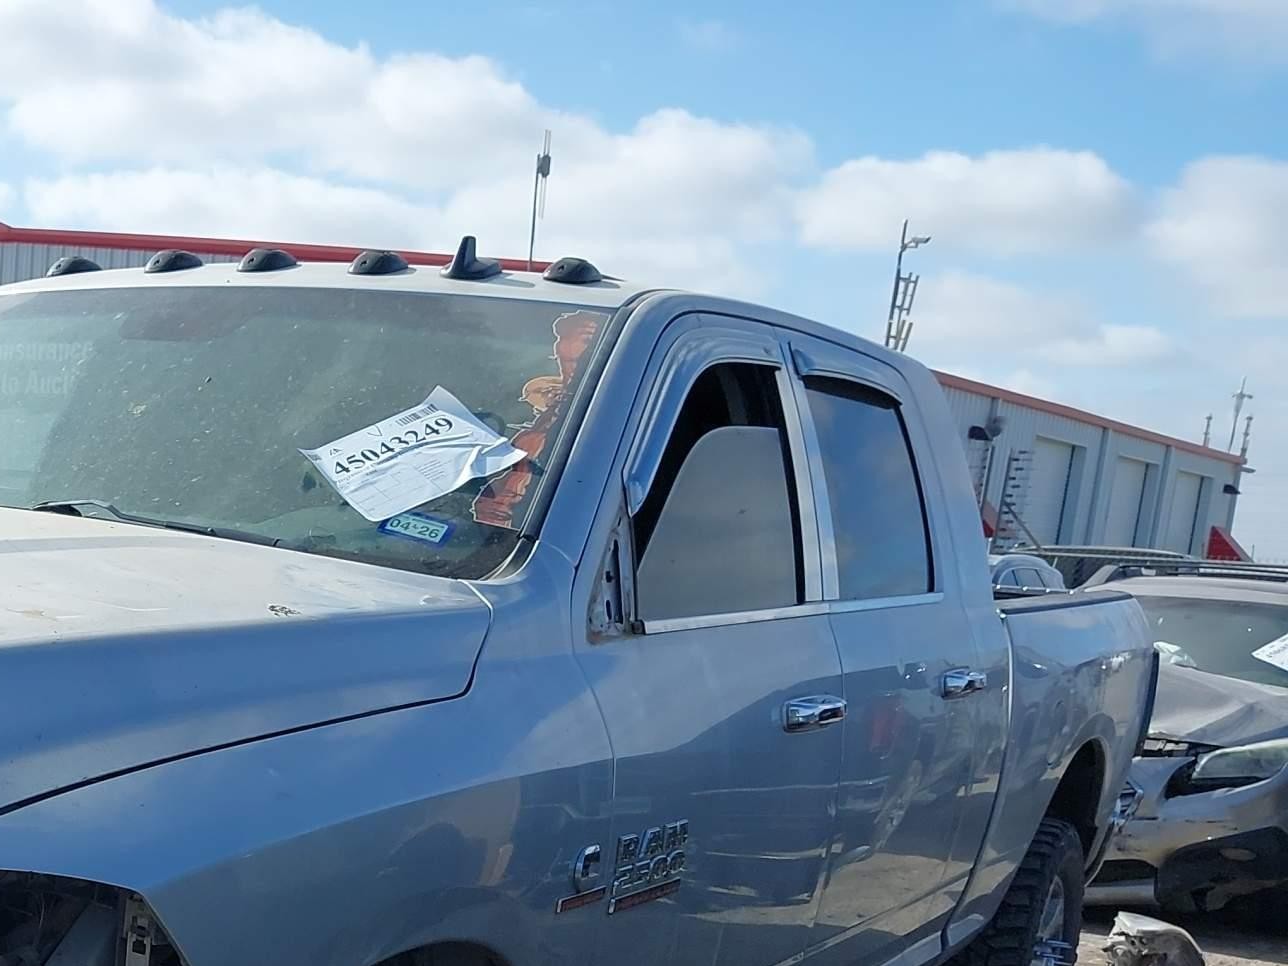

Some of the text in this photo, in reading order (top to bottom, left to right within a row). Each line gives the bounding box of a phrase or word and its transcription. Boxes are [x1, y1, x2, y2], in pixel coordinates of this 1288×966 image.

[333, 417, 454, 476] 45043249
[615, 818, 689, 866] RAM
[616, 849, 689, 889] 2500
